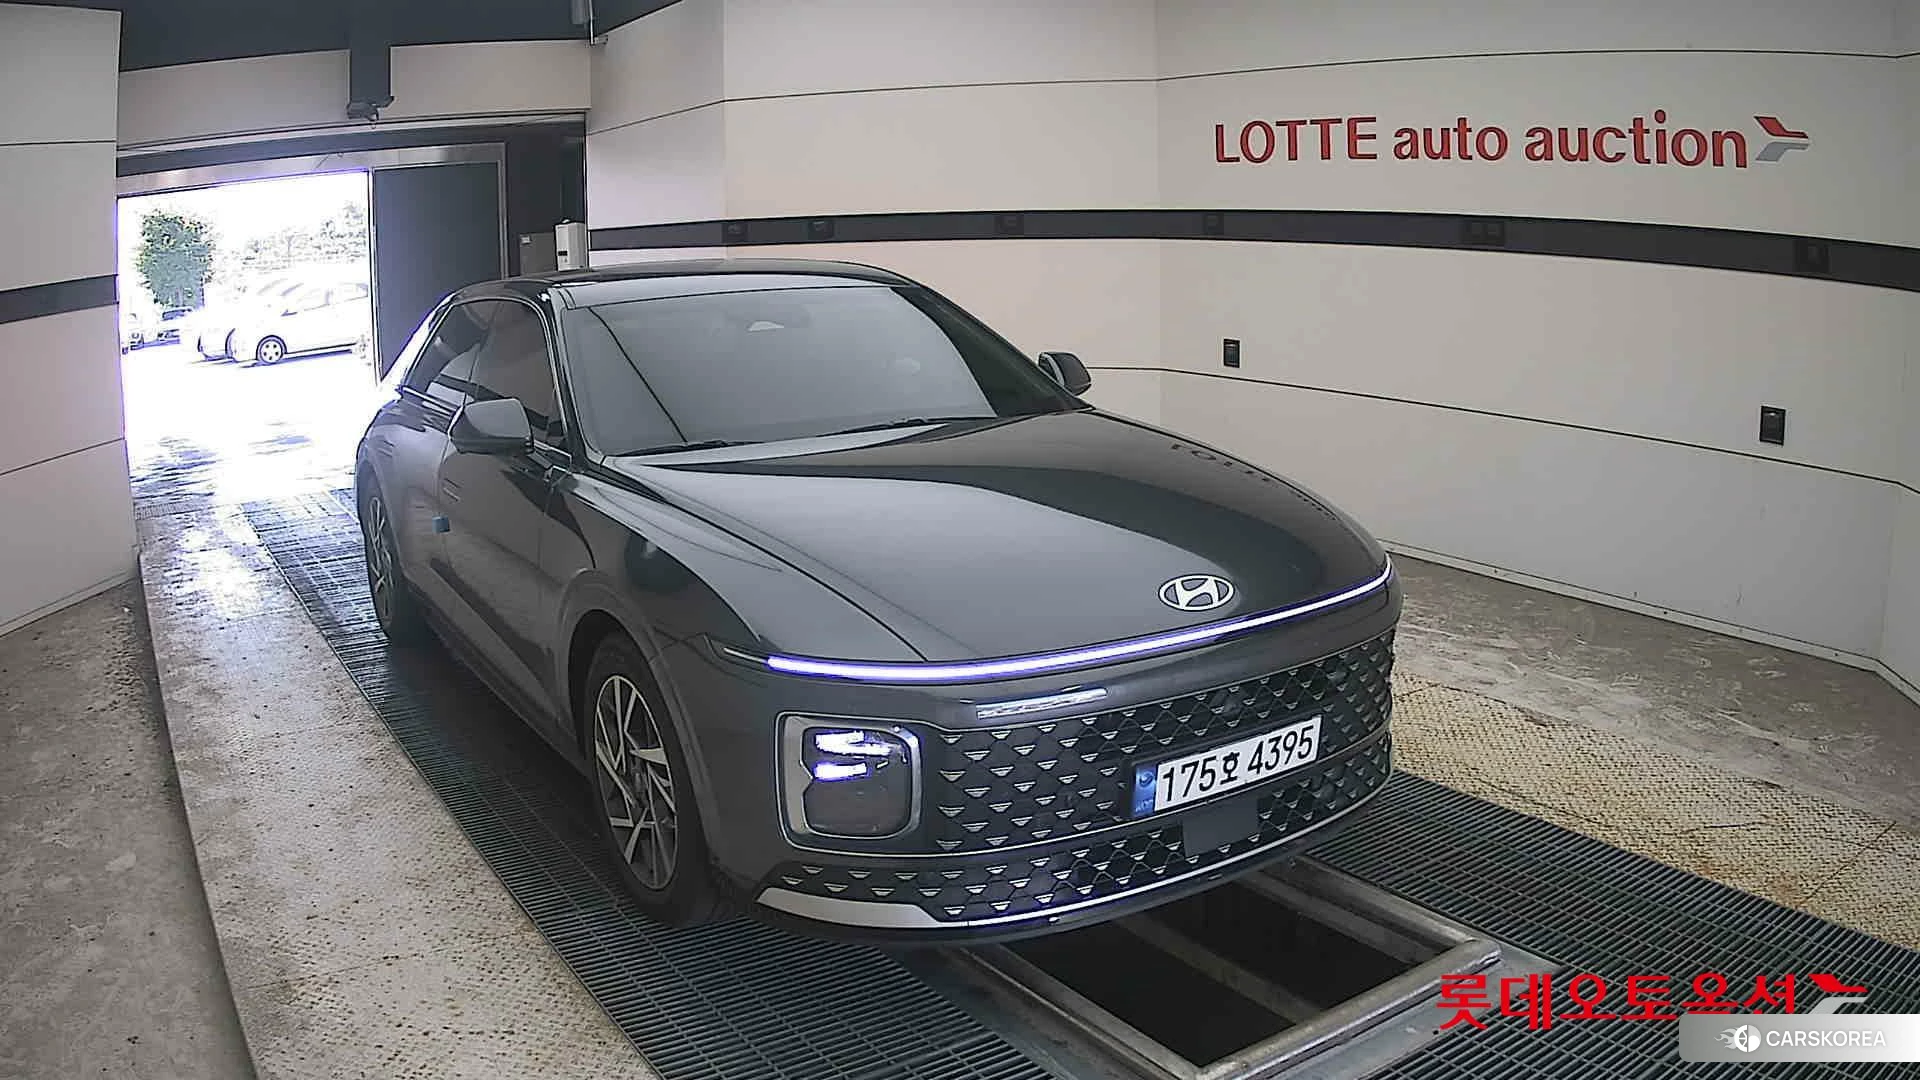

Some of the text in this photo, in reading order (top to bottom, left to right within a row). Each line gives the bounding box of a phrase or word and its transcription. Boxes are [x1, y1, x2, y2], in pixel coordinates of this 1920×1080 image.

[1215, 110, 1748, 168] LOTTE auto auction
[1162, 725, 1314, 801] 175호 4395
